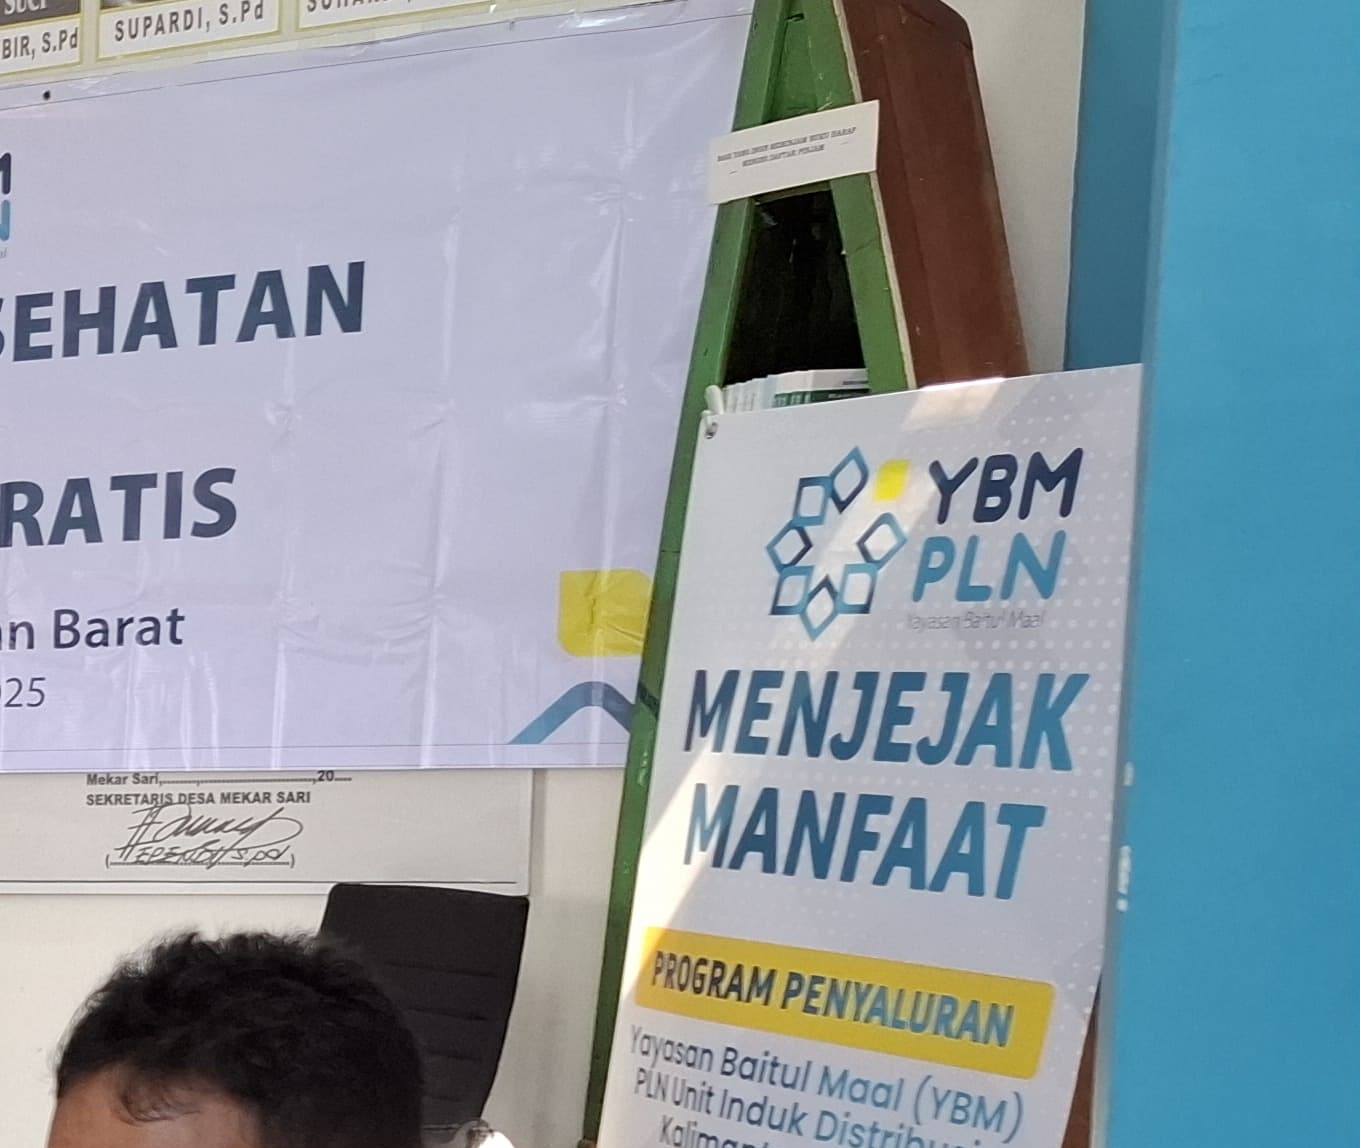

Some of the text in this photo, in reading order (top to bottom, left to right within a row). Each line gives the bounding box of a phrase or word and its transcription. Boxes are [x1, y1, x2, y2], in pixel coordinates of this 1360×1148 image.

[42, 27, 78, 53] S.Pd
[114, 0, 265, 41] SUPARDI, S.Pd
[929, 447, 1083, 525] YBM
[912, 530, 1067, 602] PLN
[52, 606, 185, 650] Barat
[684, 670, 1090, 771] MENJEJAK
[86, 791, 311, 806] SEKRETARIS DESA MEKAR SARI
[87, 773, 128, 786] Mekar
[317, 769, 335, 782] 20
[684, 783, 1048, 900] MANFAAT
[651, 950, 1015, 1048] PROGRAM PENYALURAN
[629, 1024, 1025, 1144] Yayasan Baitul Maal (YBM)
[635, 1068, 669, 1104] PLN
[672, 1078, 715, 1115] Unit
[719, 1090, 808, 1137] Induk
